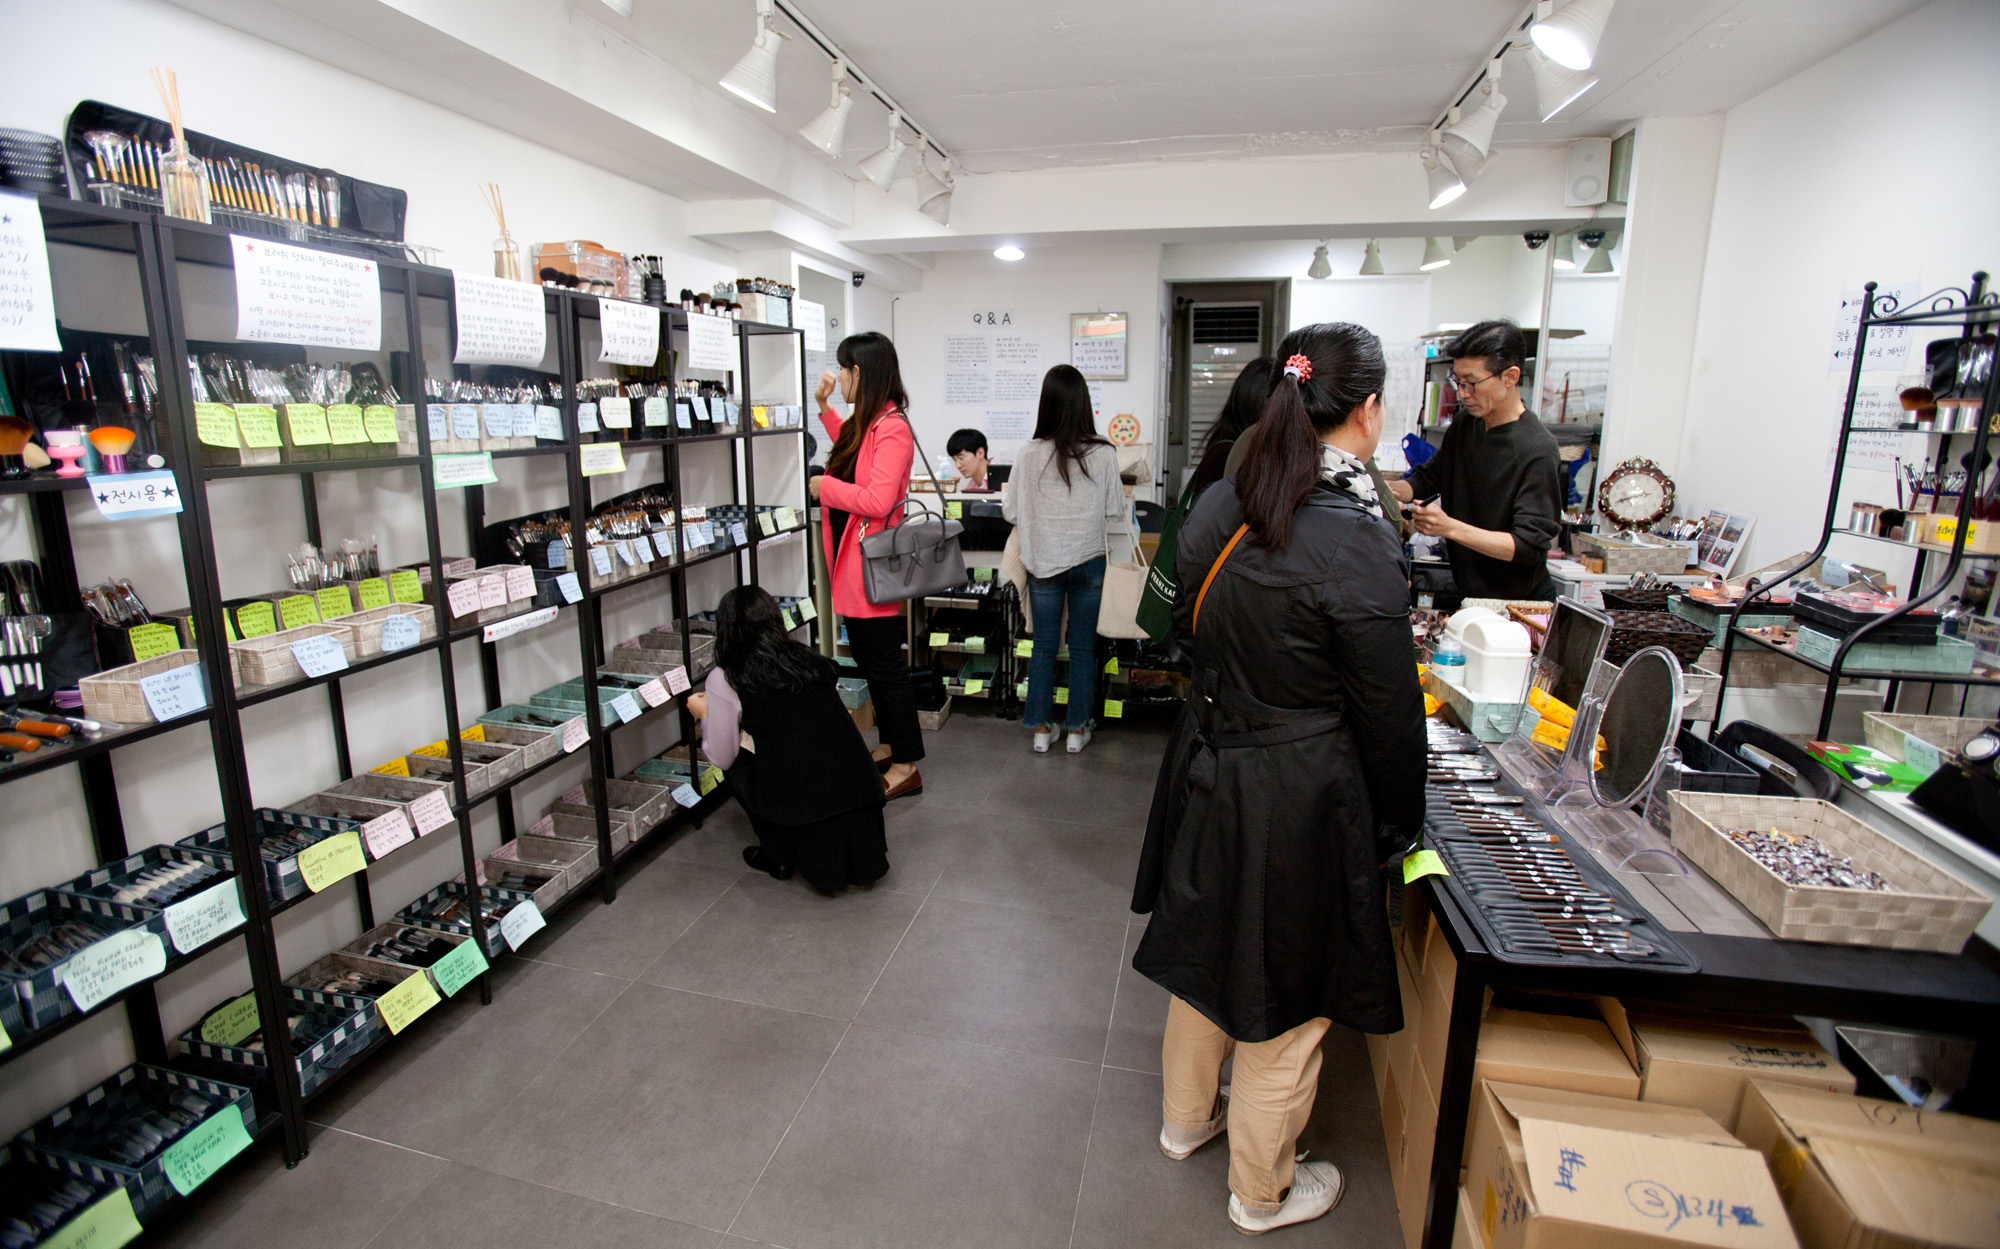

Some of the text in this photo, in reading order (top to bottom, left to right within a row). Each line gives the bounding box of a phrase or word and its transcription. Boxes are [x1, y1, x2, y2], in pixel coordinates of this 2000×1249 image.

[264, 247, 288, 259] 브러쉬
[292, 252, 315, 262] 던지지
[260, 267, 272, 275] 모든
[276, 270, 301, 279] 브러쉬는
[973, 311, 1011, 325] Q & A
[1869, 347, 1883, 358] 바로
[111, 484, 158, 504] 전시용
[1150, 571, 1165, 591] FRANZ
